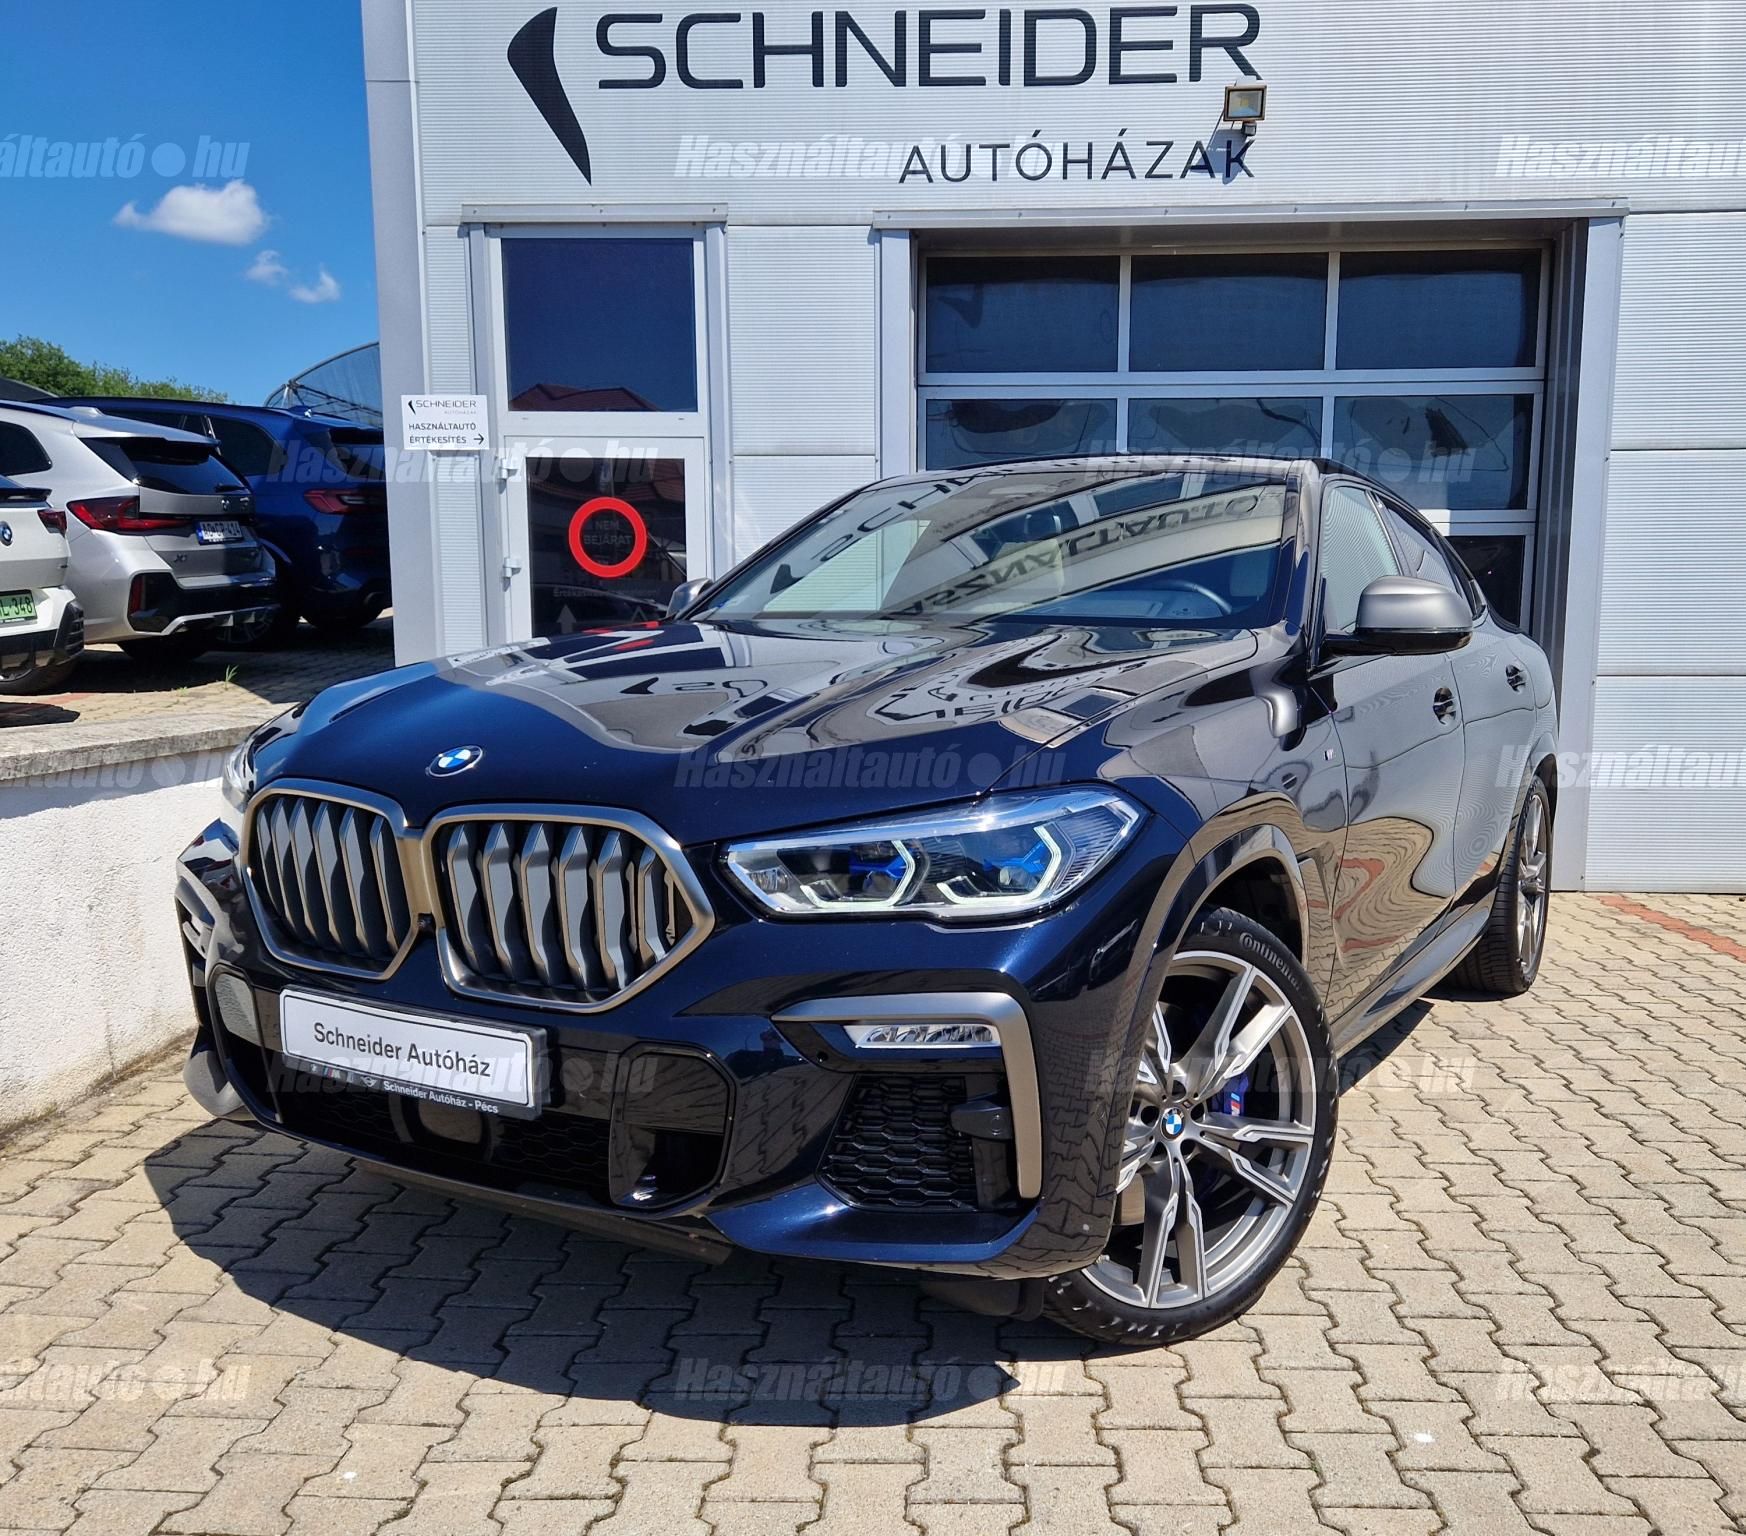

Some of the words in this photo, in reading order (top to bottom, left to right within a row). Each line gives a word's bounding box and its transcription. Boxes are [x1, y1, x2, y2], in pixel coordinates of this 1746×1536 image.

[595, 3, 1263, 90] SCHNEIDER
[898, 129, 1256, 184] AUTÓHÁZAK
[415, 400, 477, 408] SCHNEIDER
[408, 421, 477, 431] HASZNÁLTAUTÓ
[409, 435, 467, 444] ÉRTÉKESÍTÉS
[314, 1022, 402, 1060] Schneider
[407, 1043, 491, 1077] Autóház
[383, 1080, 427, 1099] Schneider
[429, 1090, 467, 1107] Autóház
[475, 1099, 499, 1114] Pécs
